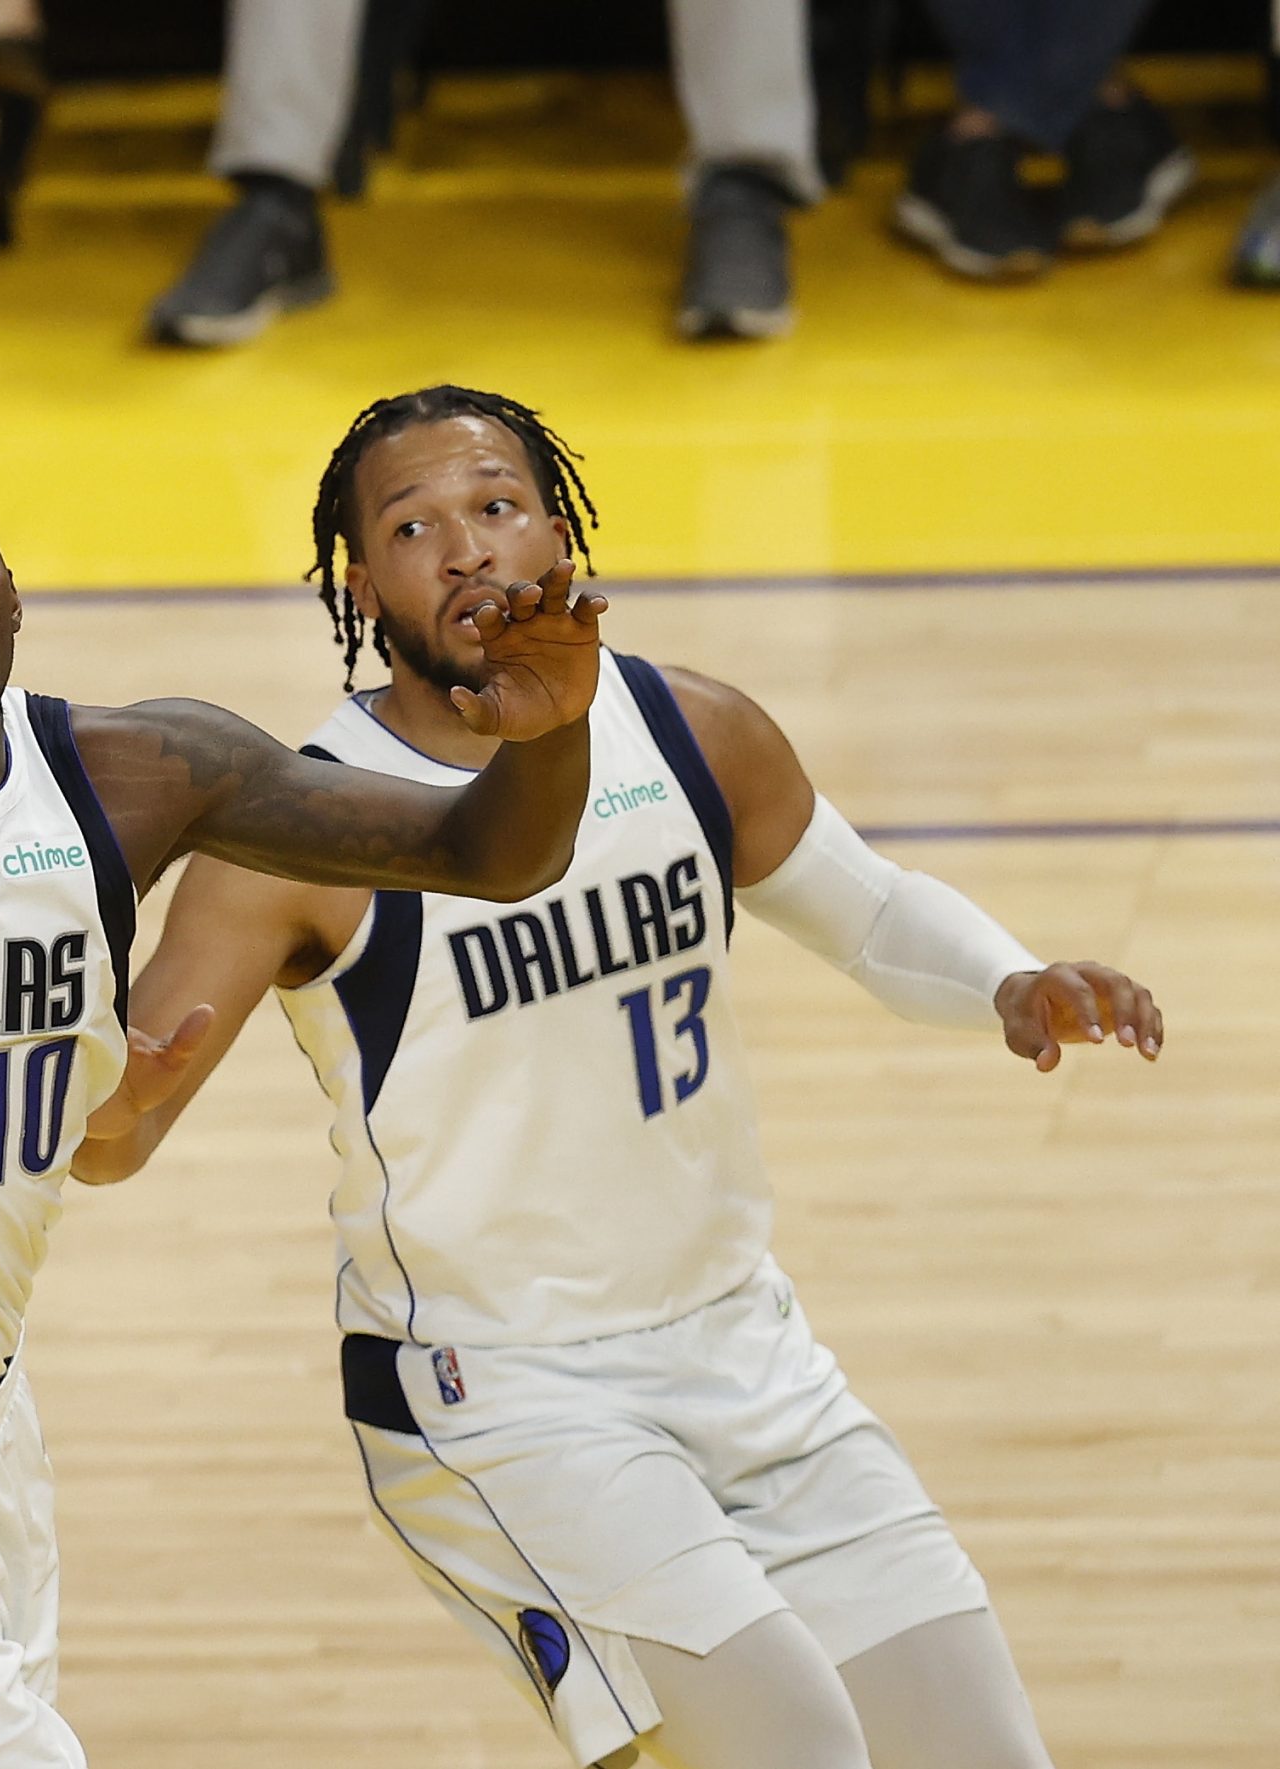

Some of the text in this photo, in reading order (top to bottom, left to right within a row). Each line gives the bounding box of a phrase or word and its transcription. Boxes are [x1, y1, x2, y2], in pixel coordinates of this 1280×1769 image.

[593, 779, 668, 818] chime
[3, 842, 86, 876] chime
[445, 852, 708, 1023] DALLAS
[617, 963, 712, 1122] 13
